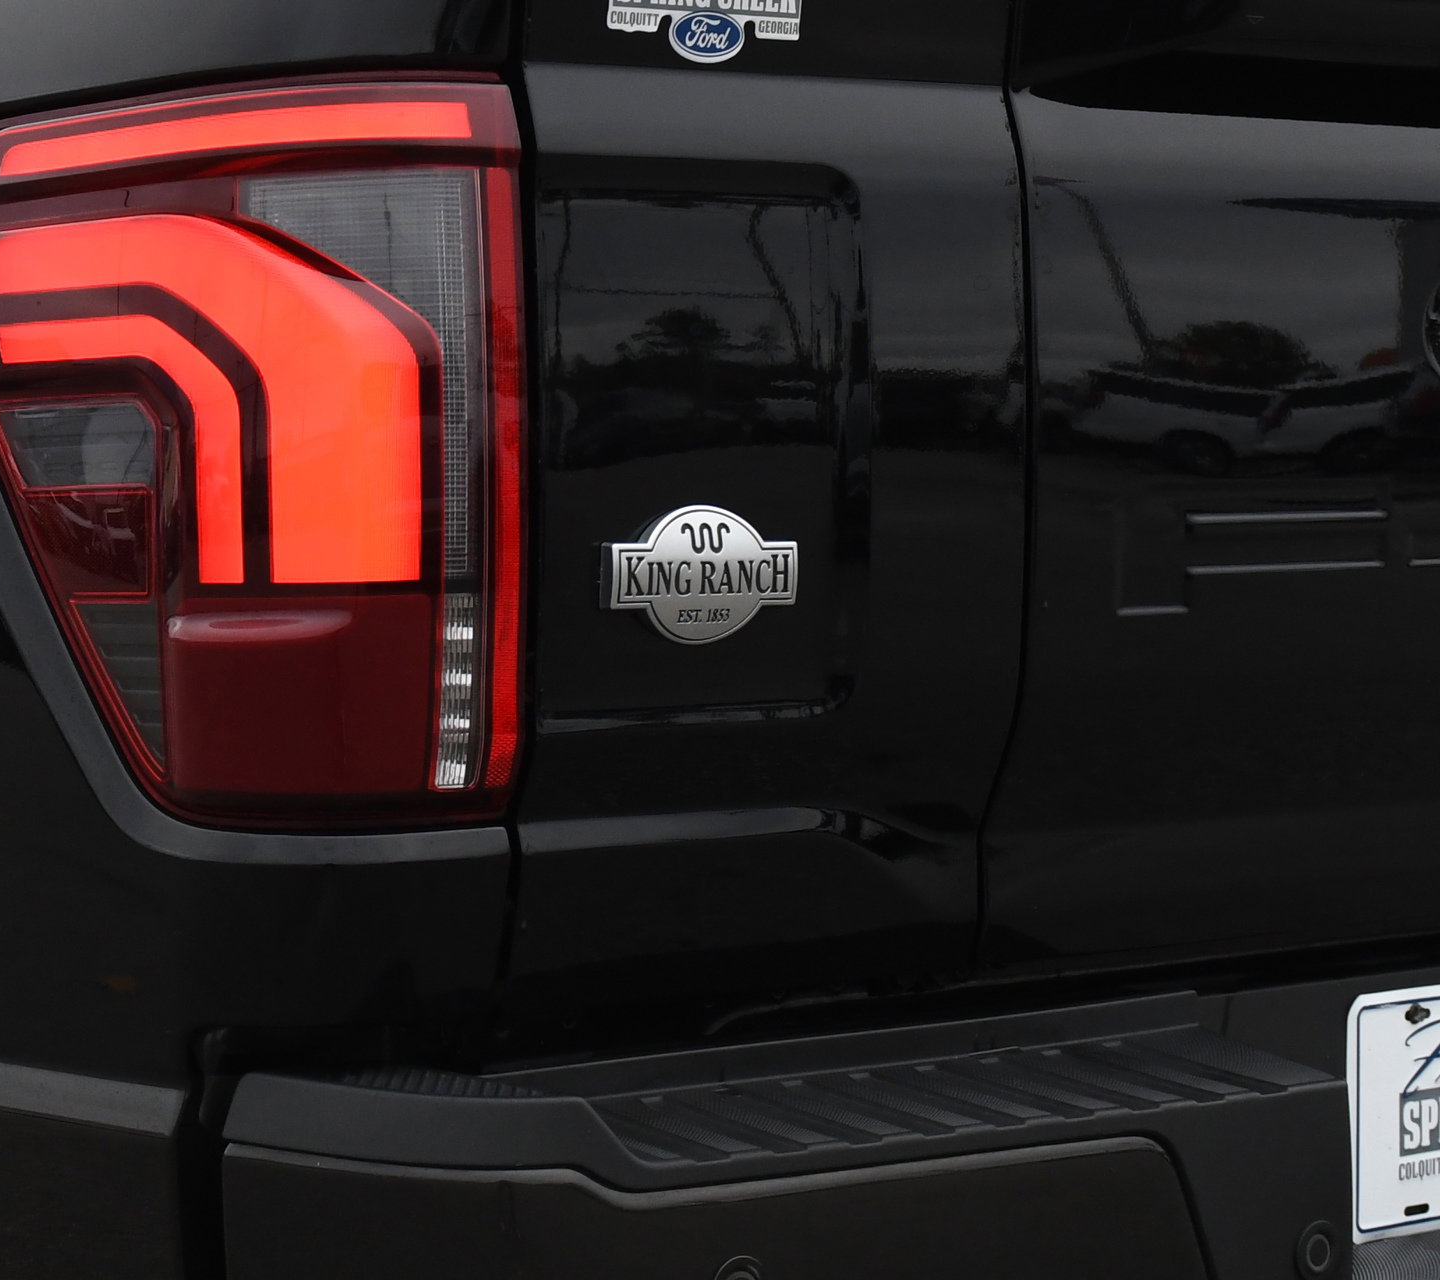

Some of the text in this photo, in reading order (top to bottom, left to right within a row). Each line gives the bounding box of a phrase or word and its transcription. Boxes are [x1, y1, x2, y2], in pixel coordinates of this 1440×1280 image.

[610, 10, 660, 27] COLQUITT
[758, 19, 799, 35] GEORGIA
[684, 15, 730, 50] Ford
[624, 553, 791, 597] KING RANCH
[677, 607, 731, 624] EST. 1853
